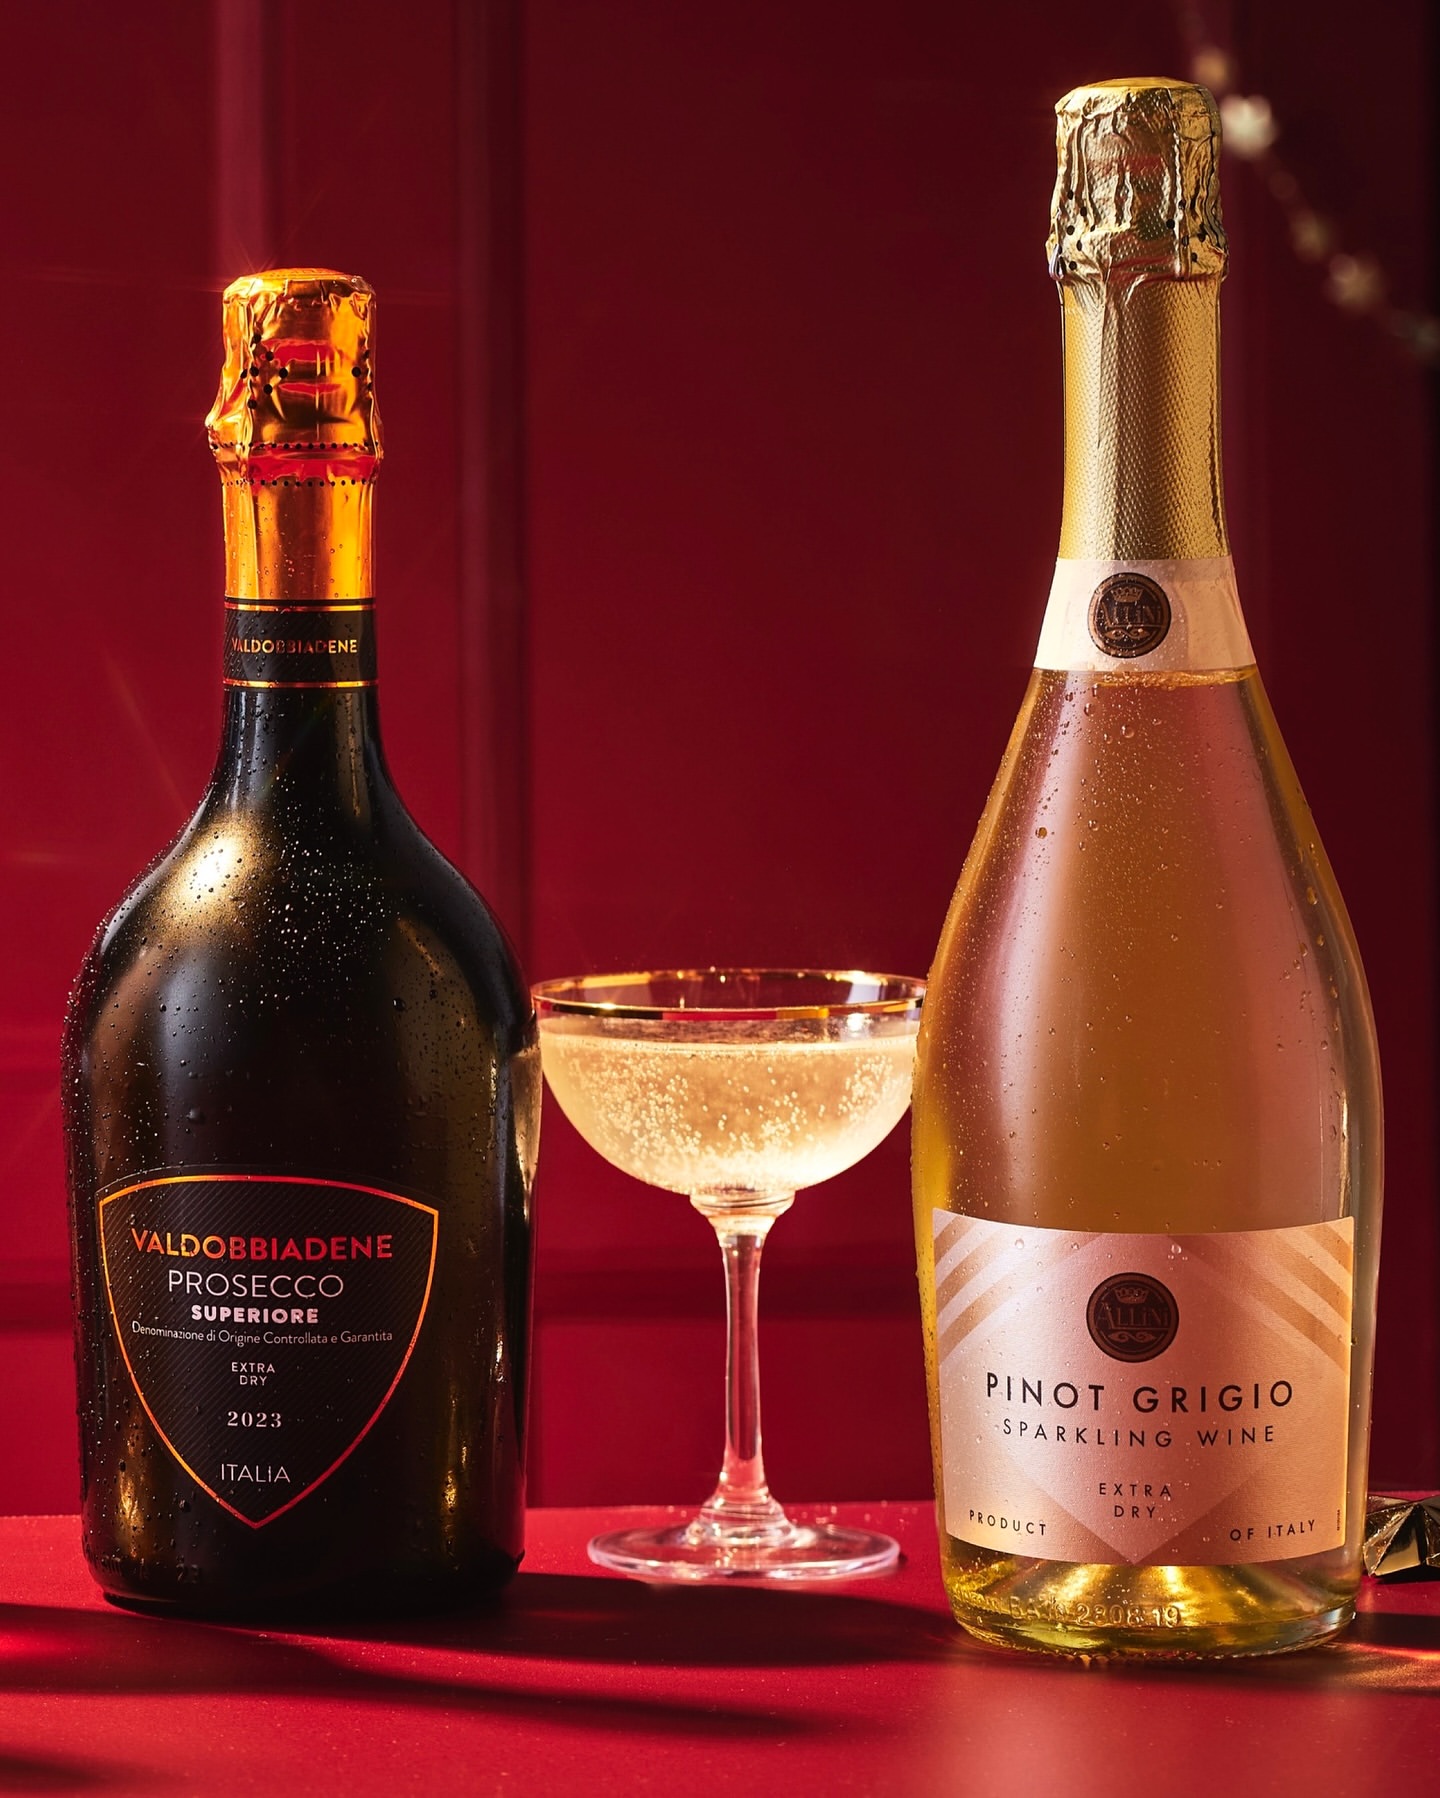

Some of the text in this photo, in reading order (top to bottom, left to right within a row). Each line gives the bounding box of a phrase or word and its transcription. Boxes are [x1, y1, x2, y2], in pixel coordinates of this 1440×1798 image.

[231, 638, 358, 654] VALDOBBIADENE
[131, 1228, 393, 1261] VALDOBBIADENE
[168, 1269, 344, 1298] PROSECCO
[191, 1304, 319, 1324] SUPERIORE
[131, 1320, 393, 1348] Denominazione di Origine Controllata e Garantita
[231, 1362, 276, 1374] EXTRA
[239, 1375, 267, 1386] DRY
[986, 1371, 1293, 1413] PINOT GRIGIO
[227, 1411, 282, 1428] 2023
[1003, 1418, 1275, 1448] SPARKLING WINE
[221, 1463, 291, 1483] ITALIA
[1099, 1483, 1172, 1497] EXTRA
[1114, 1505, 1156, 1519] DRY
[969, 1509, 1046, 1536] PRODUCT
[1229, 1519, 1315, 1541] OF ITALY
